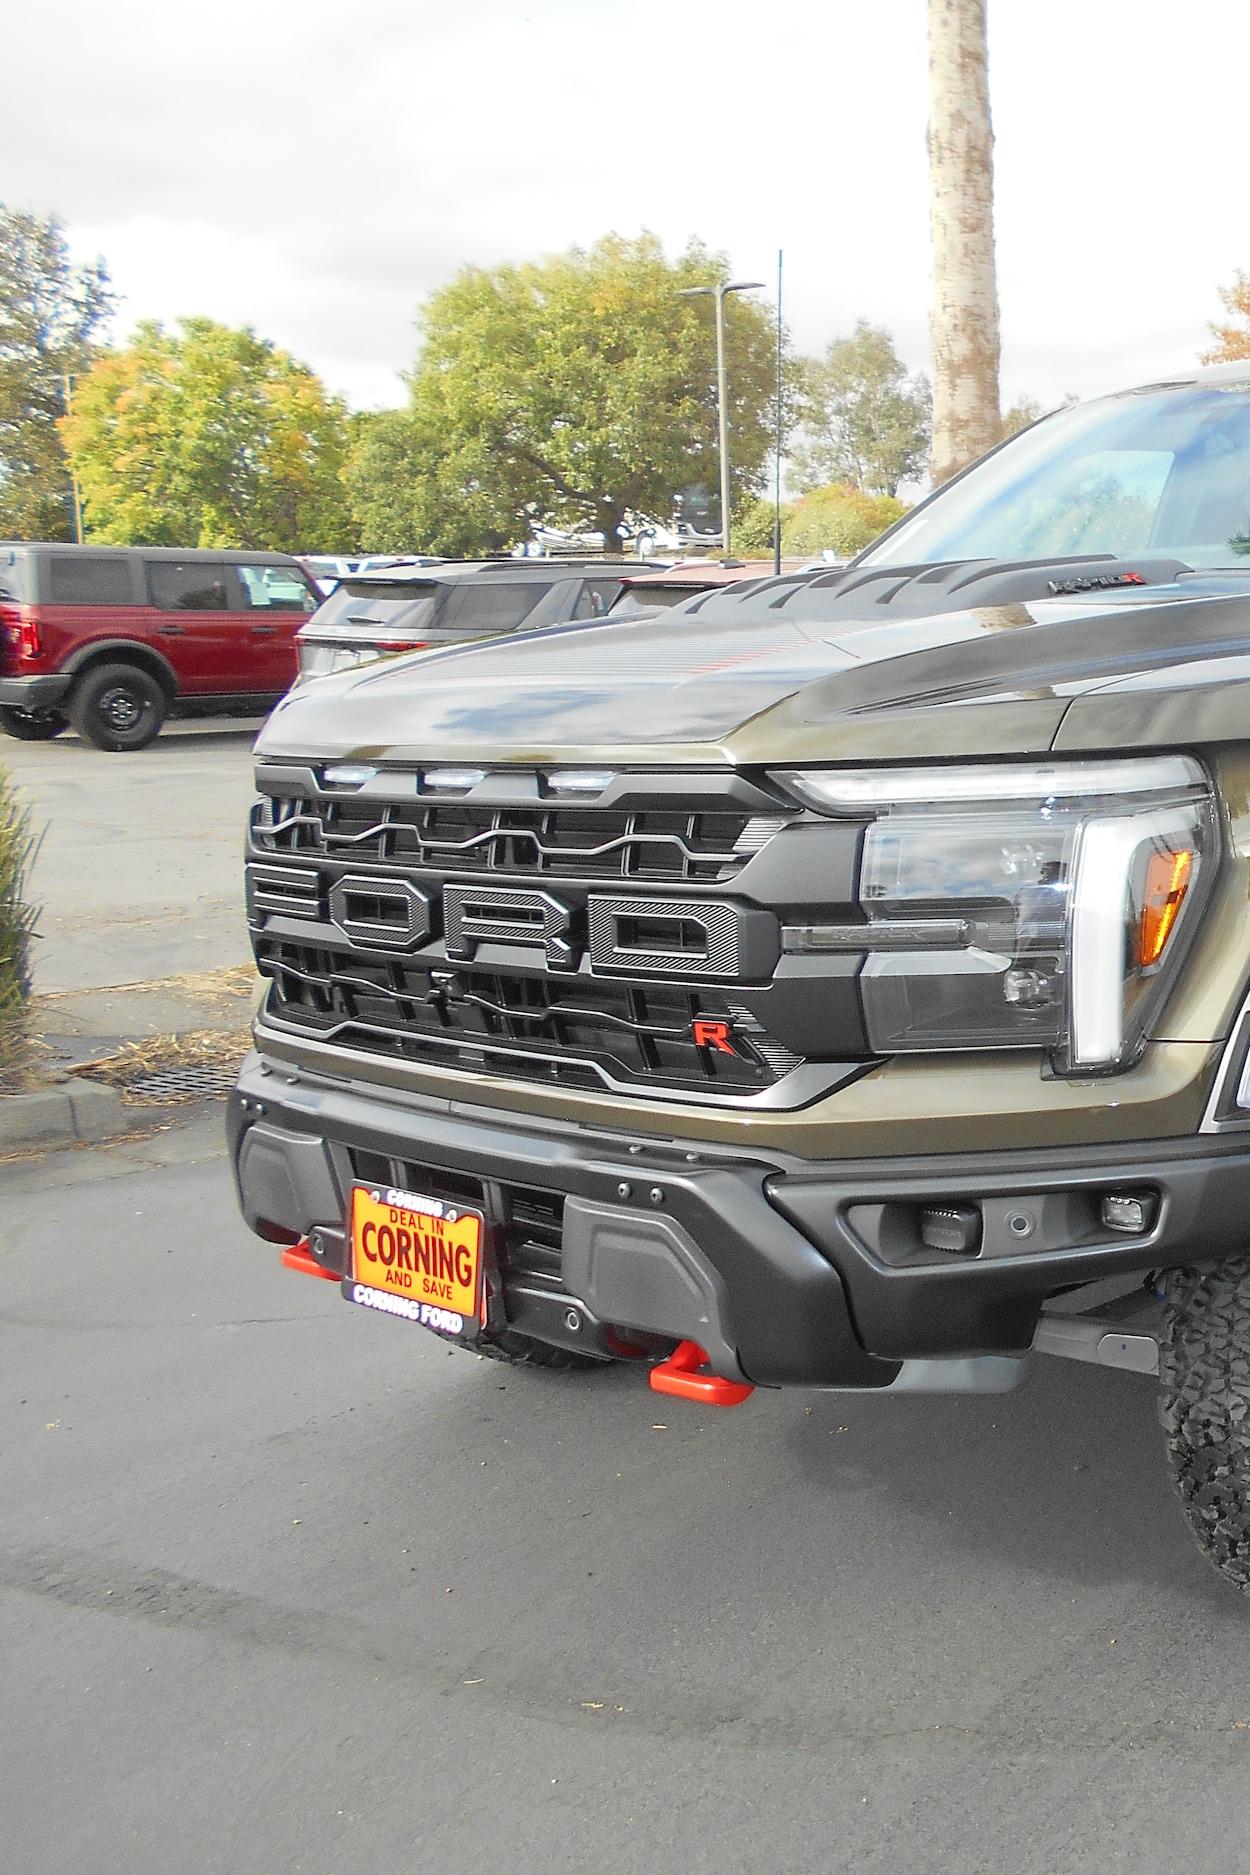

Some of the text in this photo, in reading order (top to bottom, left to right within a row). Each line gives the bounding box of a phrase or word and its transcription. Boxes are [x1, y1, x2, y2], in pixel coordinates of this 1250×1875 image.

[250, 861, 740, 978] FORD
[693, 1020, 737, 1056] R
[389, 1209, 444, 1236] DEAL IN
[361, 1221, 473, 1288] CORNING
[385, 1269, 453, 1300] AND SAVE
[353, 1283, 463, 1334] CORNING FORD
